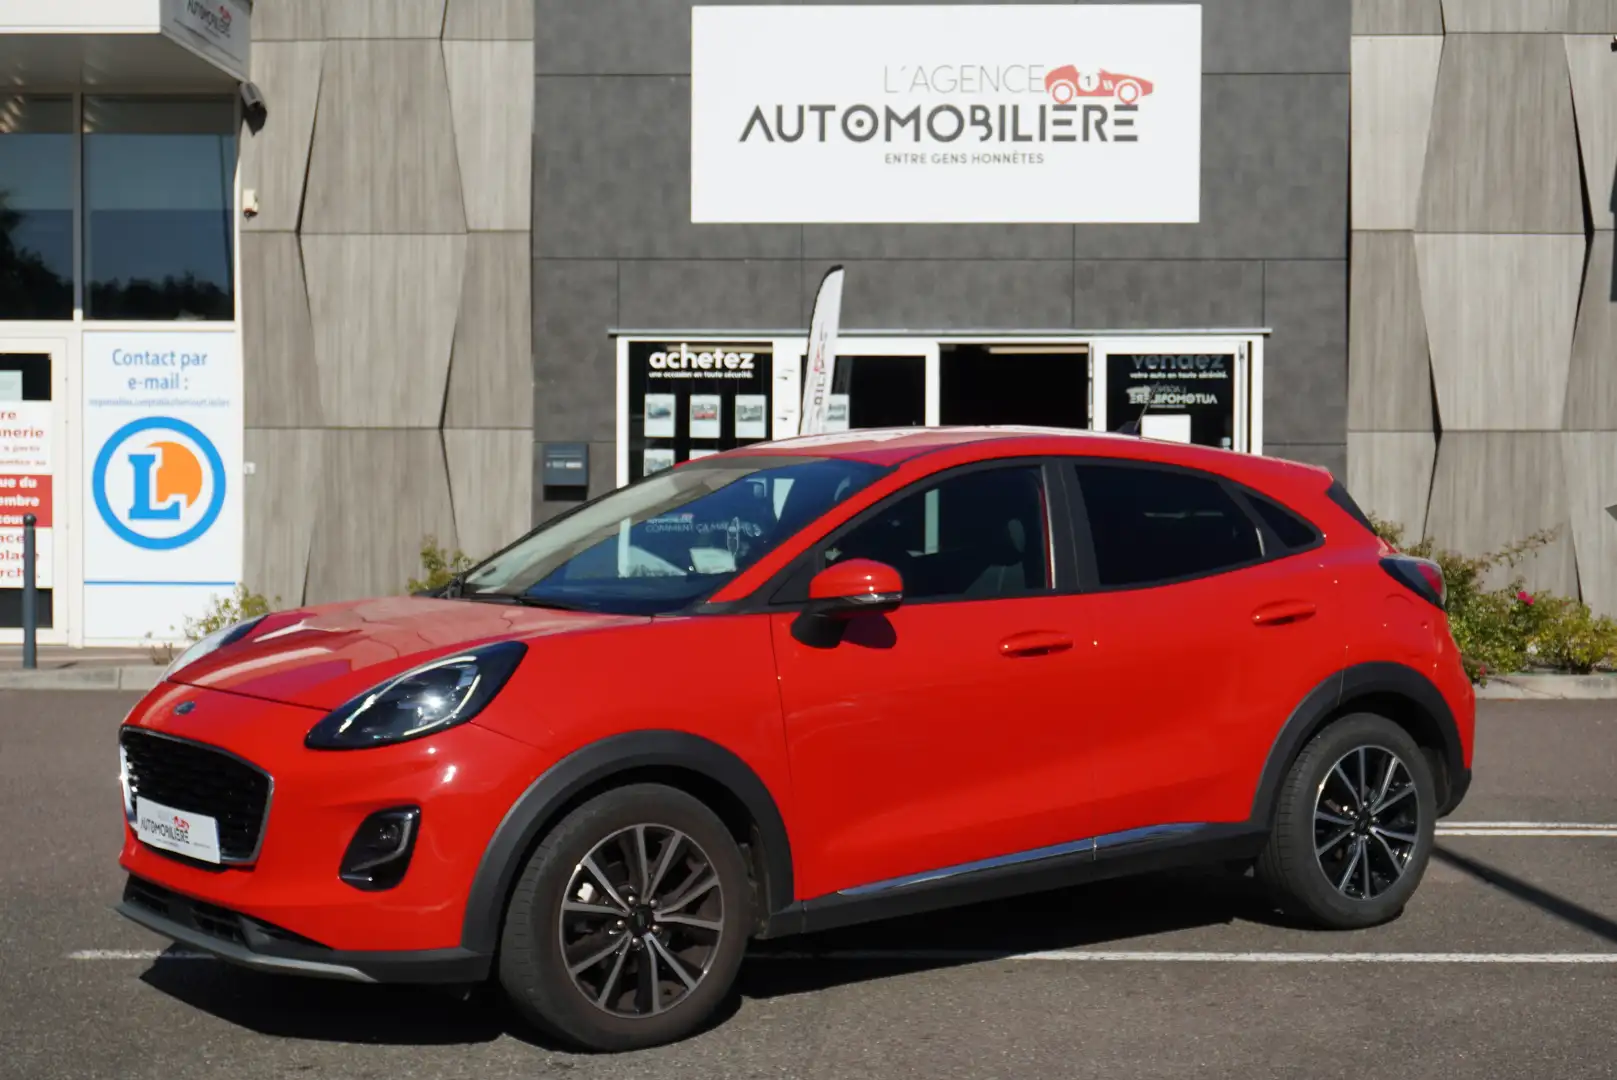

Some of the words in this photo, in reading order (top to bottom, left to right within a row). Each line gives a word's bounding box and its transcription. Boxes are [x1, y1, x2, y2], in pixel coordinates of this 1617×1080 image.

[738, 103, 1139, 143] AUTOMOBILIERE
[884, 152, 927, 164] ENTRE
[931, 152, 967, 164] GENS
[112, 348, 176, 366] Contact
[180, 353, 208, 371] par
[649, 342, 755, 369] achetez
[128, 372, 180, 390] e-mail
[0, 427, 44, 438] nerie
[19, 475, 38, 489] du
